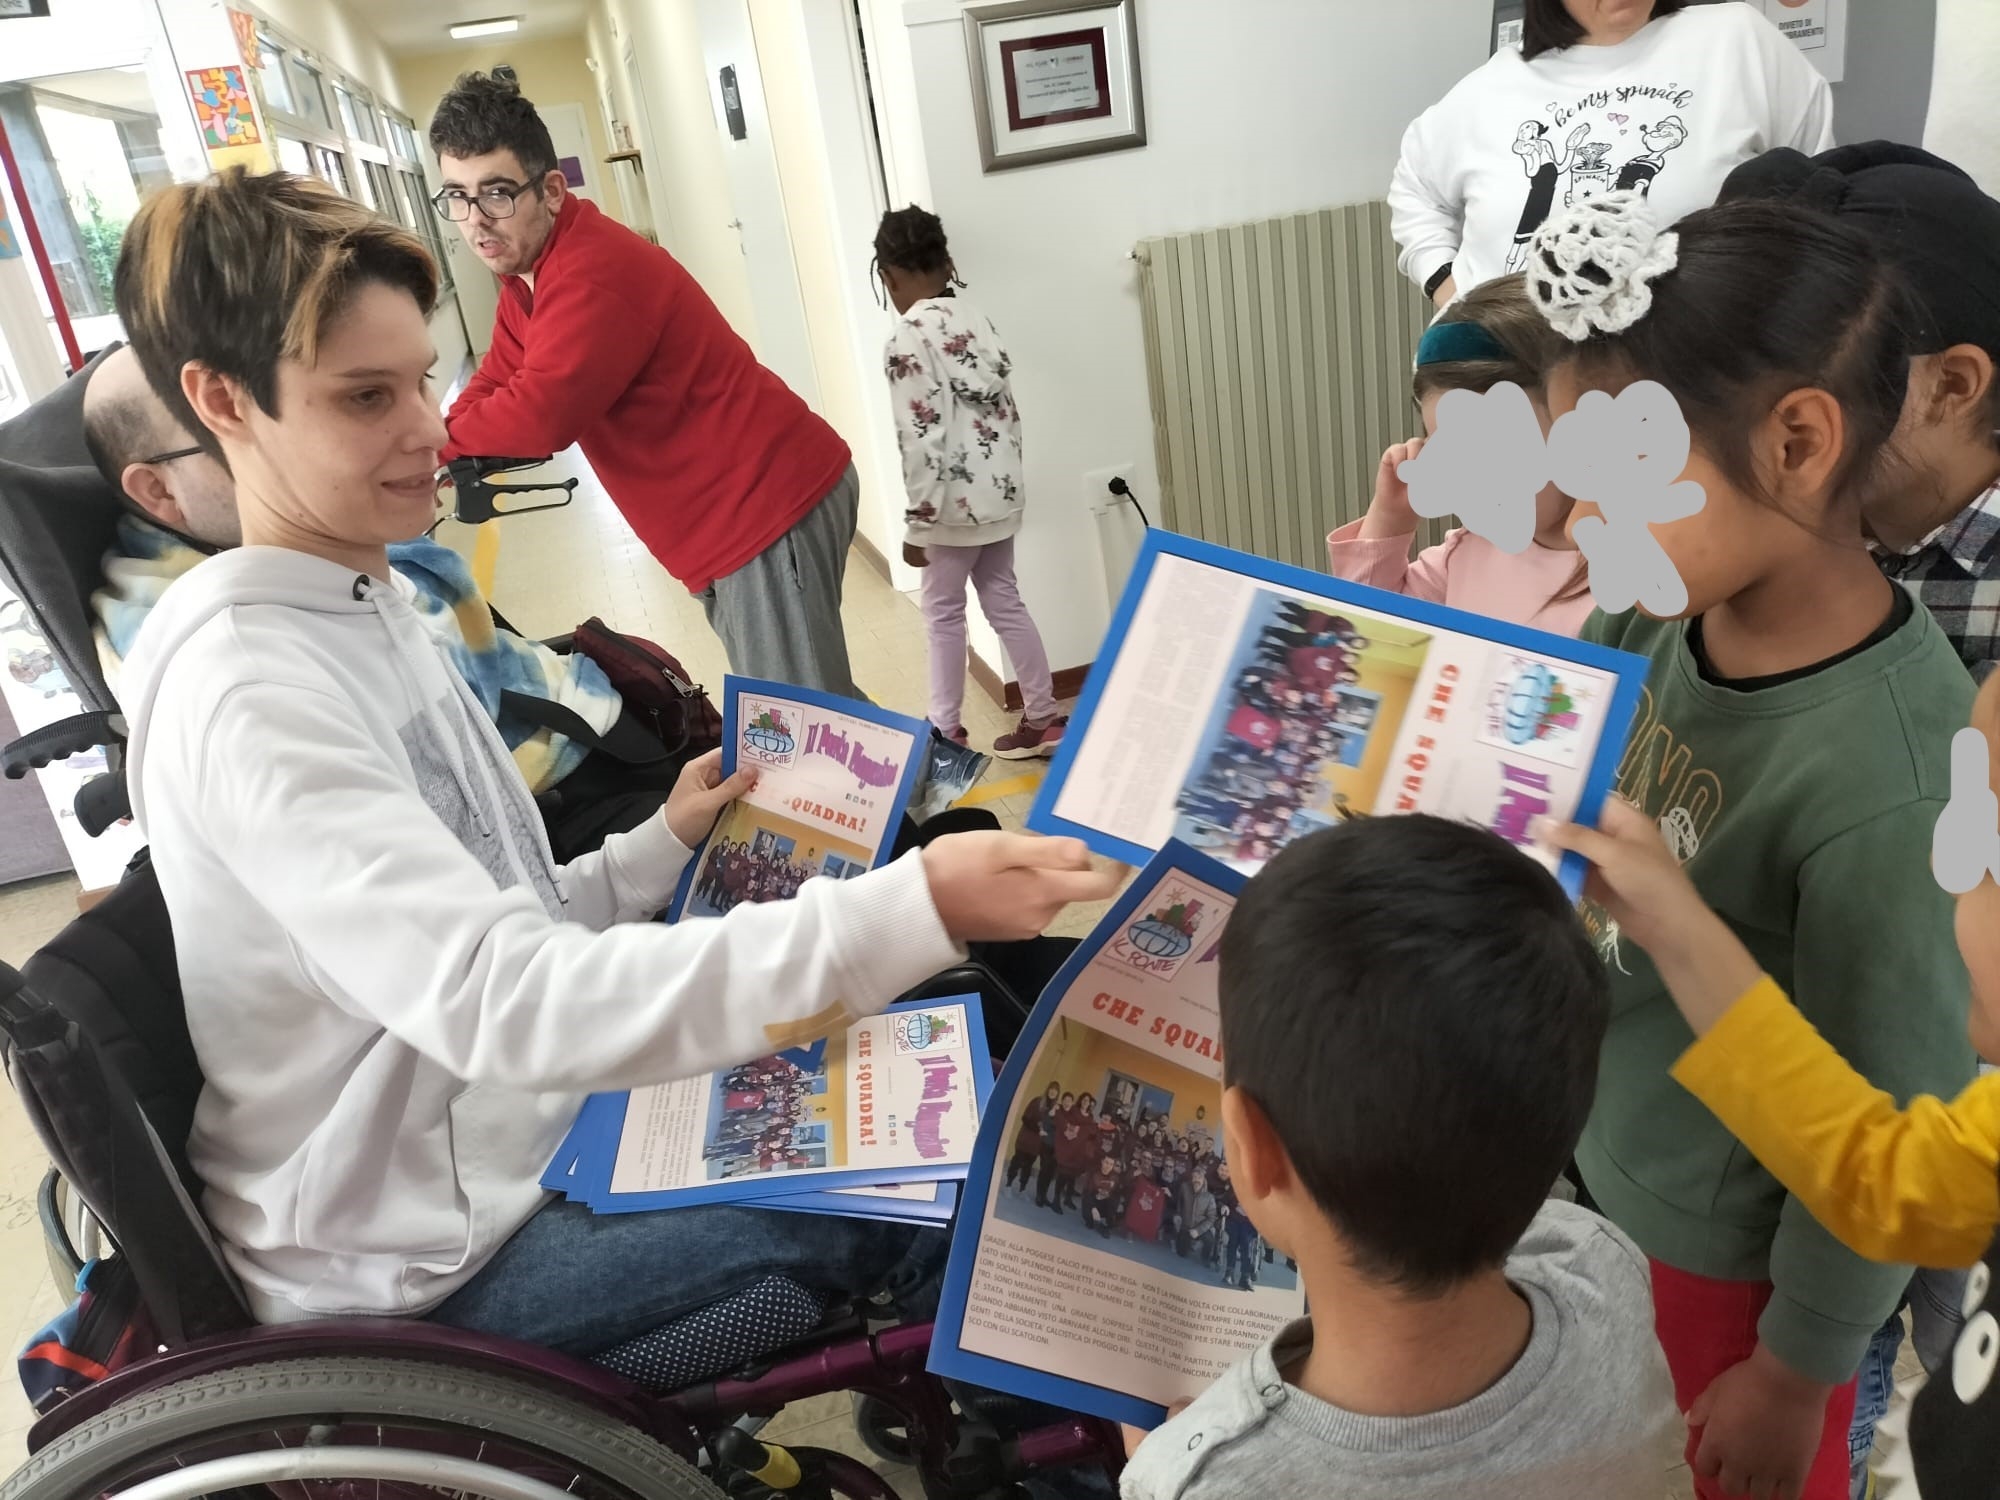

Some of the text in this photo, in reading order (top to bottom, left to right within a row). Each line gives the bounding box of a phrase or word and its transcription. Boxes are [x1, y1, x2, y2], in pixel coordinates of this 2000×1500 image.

[1778, 18, 1812, 31] DIVIETO DI
[1577, 90, 1613, 110] my
[1615, 85, 1693, 109] spinach
[1574, 174, 1606, 184] SPINACH
[1395, 664, 1460, 811] CHE SQUA
[1127, 952, 1180, 972] PONTE
[1092, 992, 1144, 1026] CHE
[895, 1027, 914, 1052] PONTE
[856, 1030, 878, 1146] CHE SQUADRA!
[984, 1234, 1006, 1246] GRAZIE
[1009, 1242, 1023, 1252] ALLA
[1025, 1247, 1054, 1261] POGGESE
[1057, 1257, 1080, 1269] CALCIO
[1082, 1264, 1093, 1273] PER
[980, 1257, 995, 1267] LORI
[1029, 1272, 1053, 1285] NOSTRI
[1055, 1279, 1076, 1291] LOGHI
[1097, 1292, 1123, 1305] NUMERI
[981, 1245, 999, 1256] LATO
[1001, 1251, 1019, 1262] VENTI
[1022, 1258, 1054, 1273] SPLENDIDE
[1057, 1268, 1092, 1284] MAGLIETTE
[1094, 1279, 1106, 1288] COI
[1107, 1283, 1124, 1294] LORO
[994, 1274, 1012, 1285] SONO
[973, 1292, 1003, 1306] QUANDO
[1004, 1301, 1035, 1315] ABBIAMO
[1039, 1311, 1057, 1322] VISTO
[1059, 1316, 1091, 1331] ARRIVARE
[1093, 1326, 1116, 1339] ALCUNI
[983, 1282, 1004, 1294] STATA
[1008, 1289, 1047, 1307] VERAMENTE
[1051, 1302, 1067, 1312] UNA
[1071, 1307, 1097, 1321] GRANDE
[1102, 1317, 1133, 1332] SORPRESA
[1142, 1282, 1155, 1293] NON
[1169, 1293, 1187, 1304] PRIMA
[1189, 1300, 1210, 1310] VOLTA
[1212, 1304, 1226, 1312] CHE
[1227, 1306, 1283, 1323] COLLABORIAMO
[969, 1316, 981, 1325] SCO
[983, 1320, 998, 1330] CON
[993, 1310, 1013, 1322] DELLA
[1046, 1325, 1081, 1341] CALCISTICA
[1092, 1338, 1118, 1352] POGGIO
[1168, 1315, 1214, 1333] SICURAMENTE
[1224, 1328, 1259, 1340] SARANNO
[1203, 1314, 1231, 1325] SEMPRE
[1247, 1320, 1276, 1333] GRANDE
[1136, 1339, 1159, 1353] QUESTA
[1168, 1351, 1181, 1360] UNA
[1184, 1356, 1213, 1367] PARTITA
[1209, 1338, 1231, 1347] STARE
[1182, 1367, 1211, 1379] ANCORA
